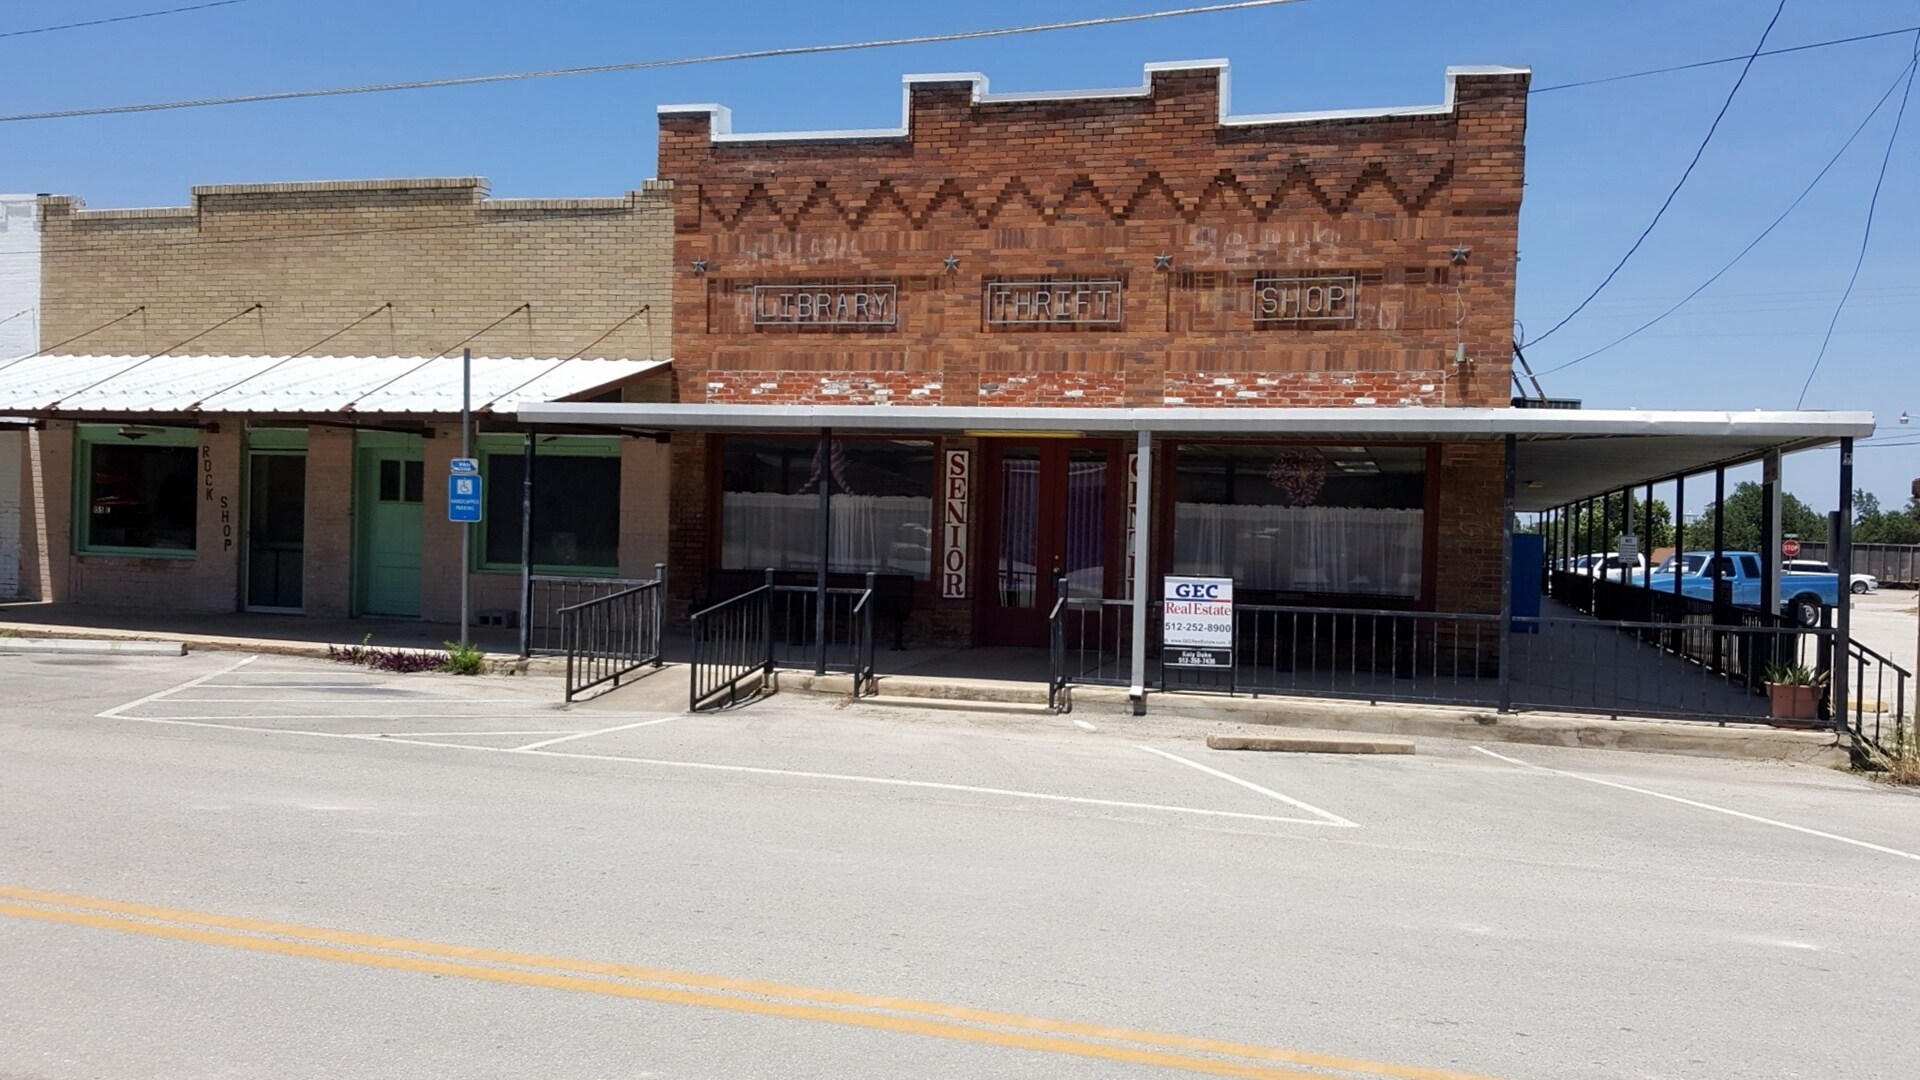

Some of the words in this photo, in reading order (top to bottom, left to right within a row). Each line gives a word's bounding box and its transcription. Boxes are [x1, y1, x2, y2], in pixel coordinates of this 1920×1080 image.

[760, 292, 888, 318] LIBRARY
[996, 290, 1112, 316] THRIFT
[1261, 285, 1346, 314] SHOP
[202, 445, 214, 501] ROCK
[220, 496, 232, 552] SHOP
[944, 452, 966, 596] SENIOR
[1175, 583, 1219, 599] GEC
[1165, 602, 1192, 615] Real
[1194, 602, 1232, 616] Estate
[1165, 622, 1232, 633] 512-252-8900
